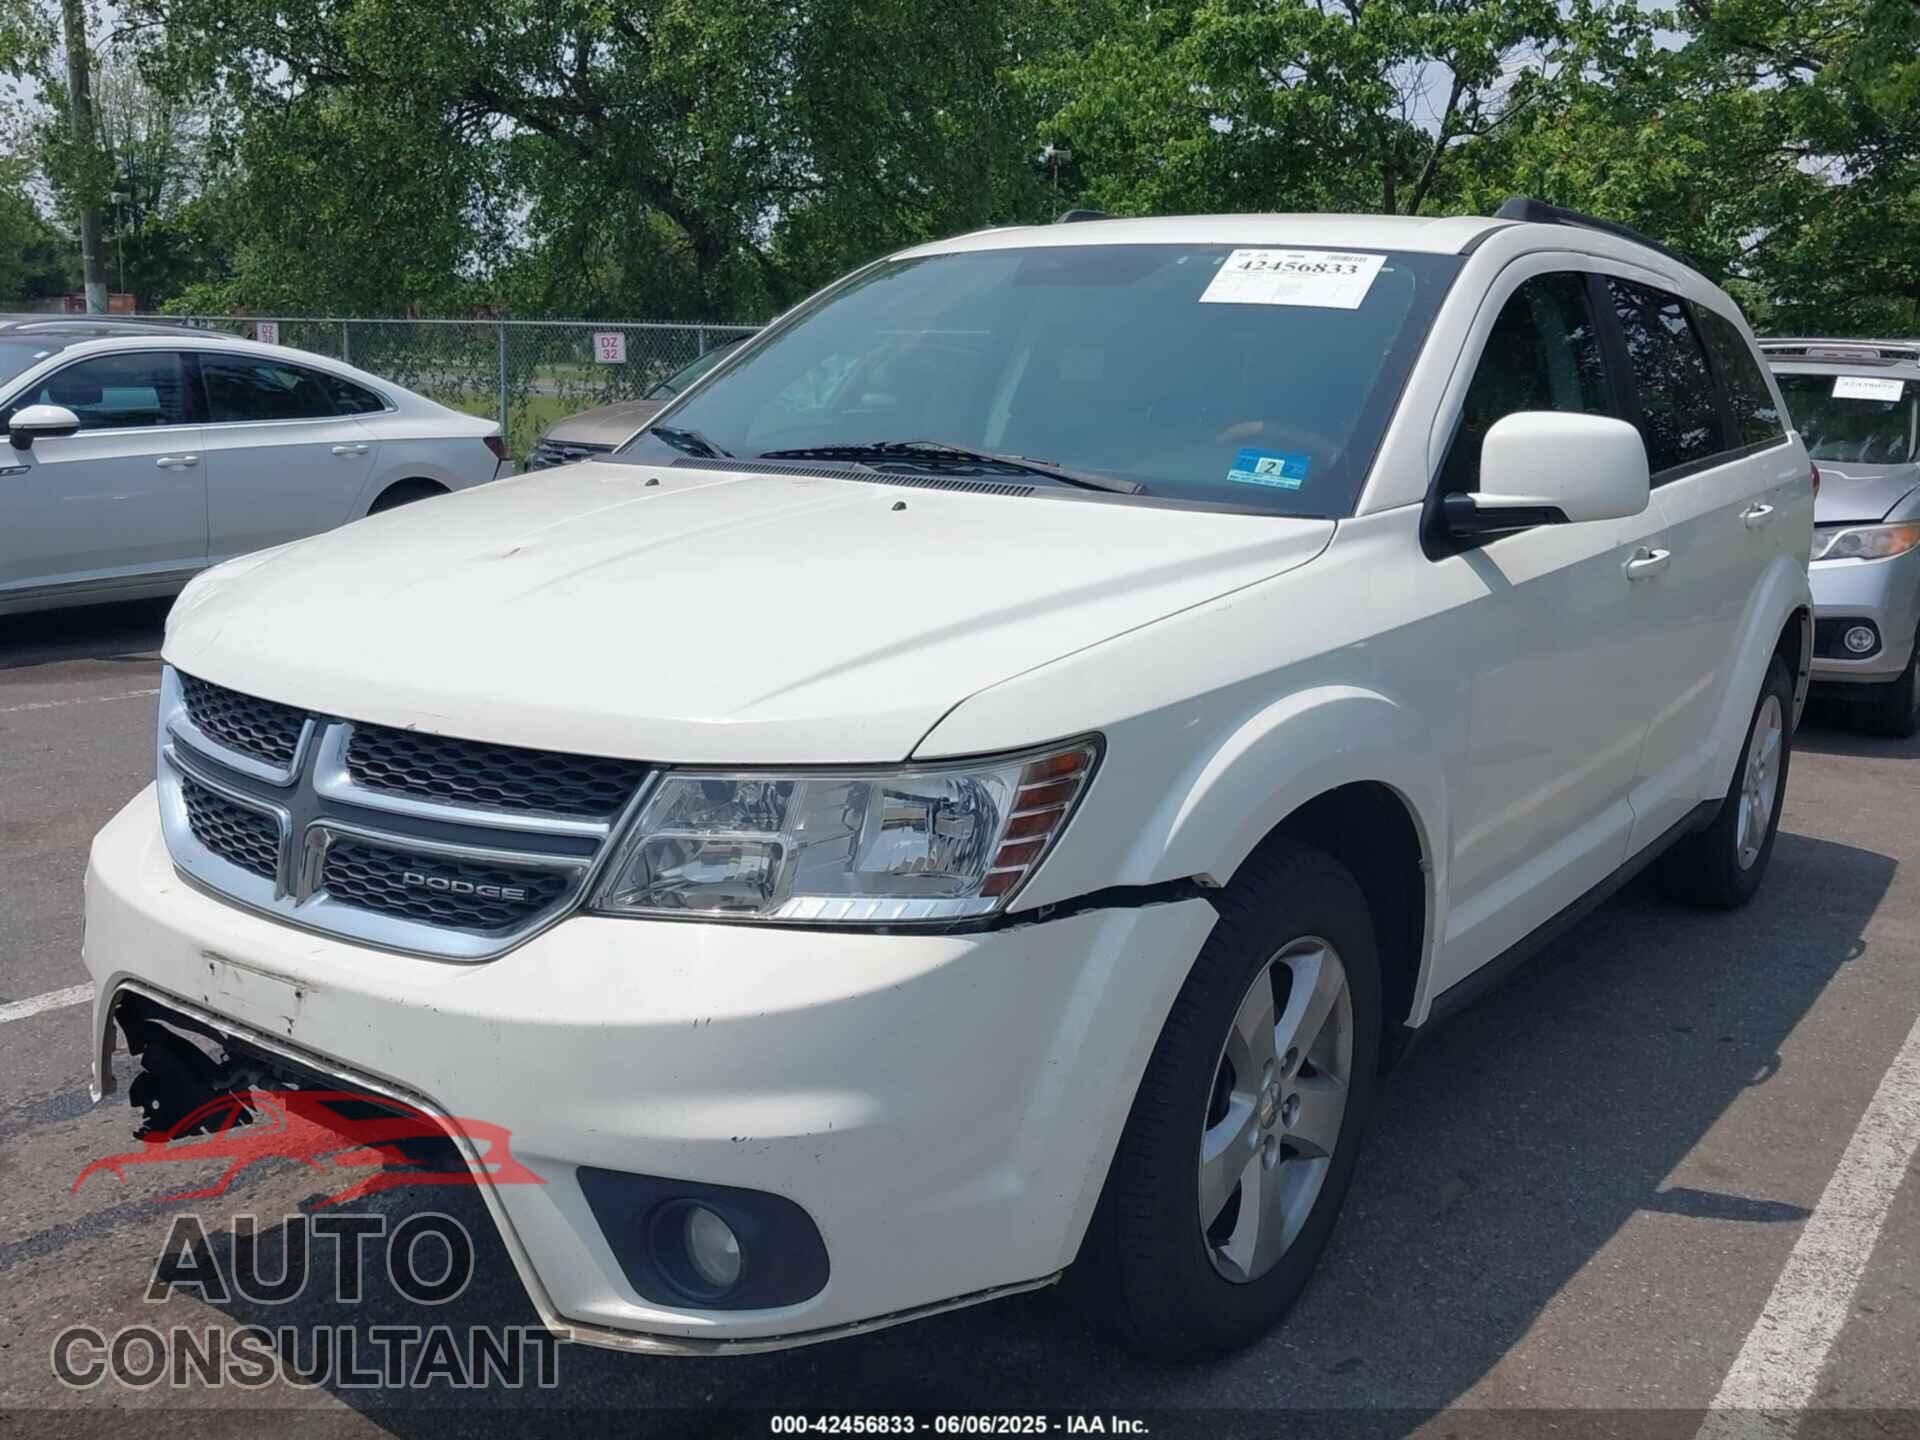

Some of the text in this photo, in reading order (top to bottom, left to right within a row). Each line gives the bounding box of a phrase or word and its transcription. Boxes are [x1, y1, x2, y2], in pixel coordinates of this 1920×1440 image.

[1237, 260, 1359, 275] 42456833
[601, 337, 618, 348] DZ
[603, 349, 618, 360] 32
[1264, 461, 1277, 474] 2
[402, 871, 526, 901] DODGE
